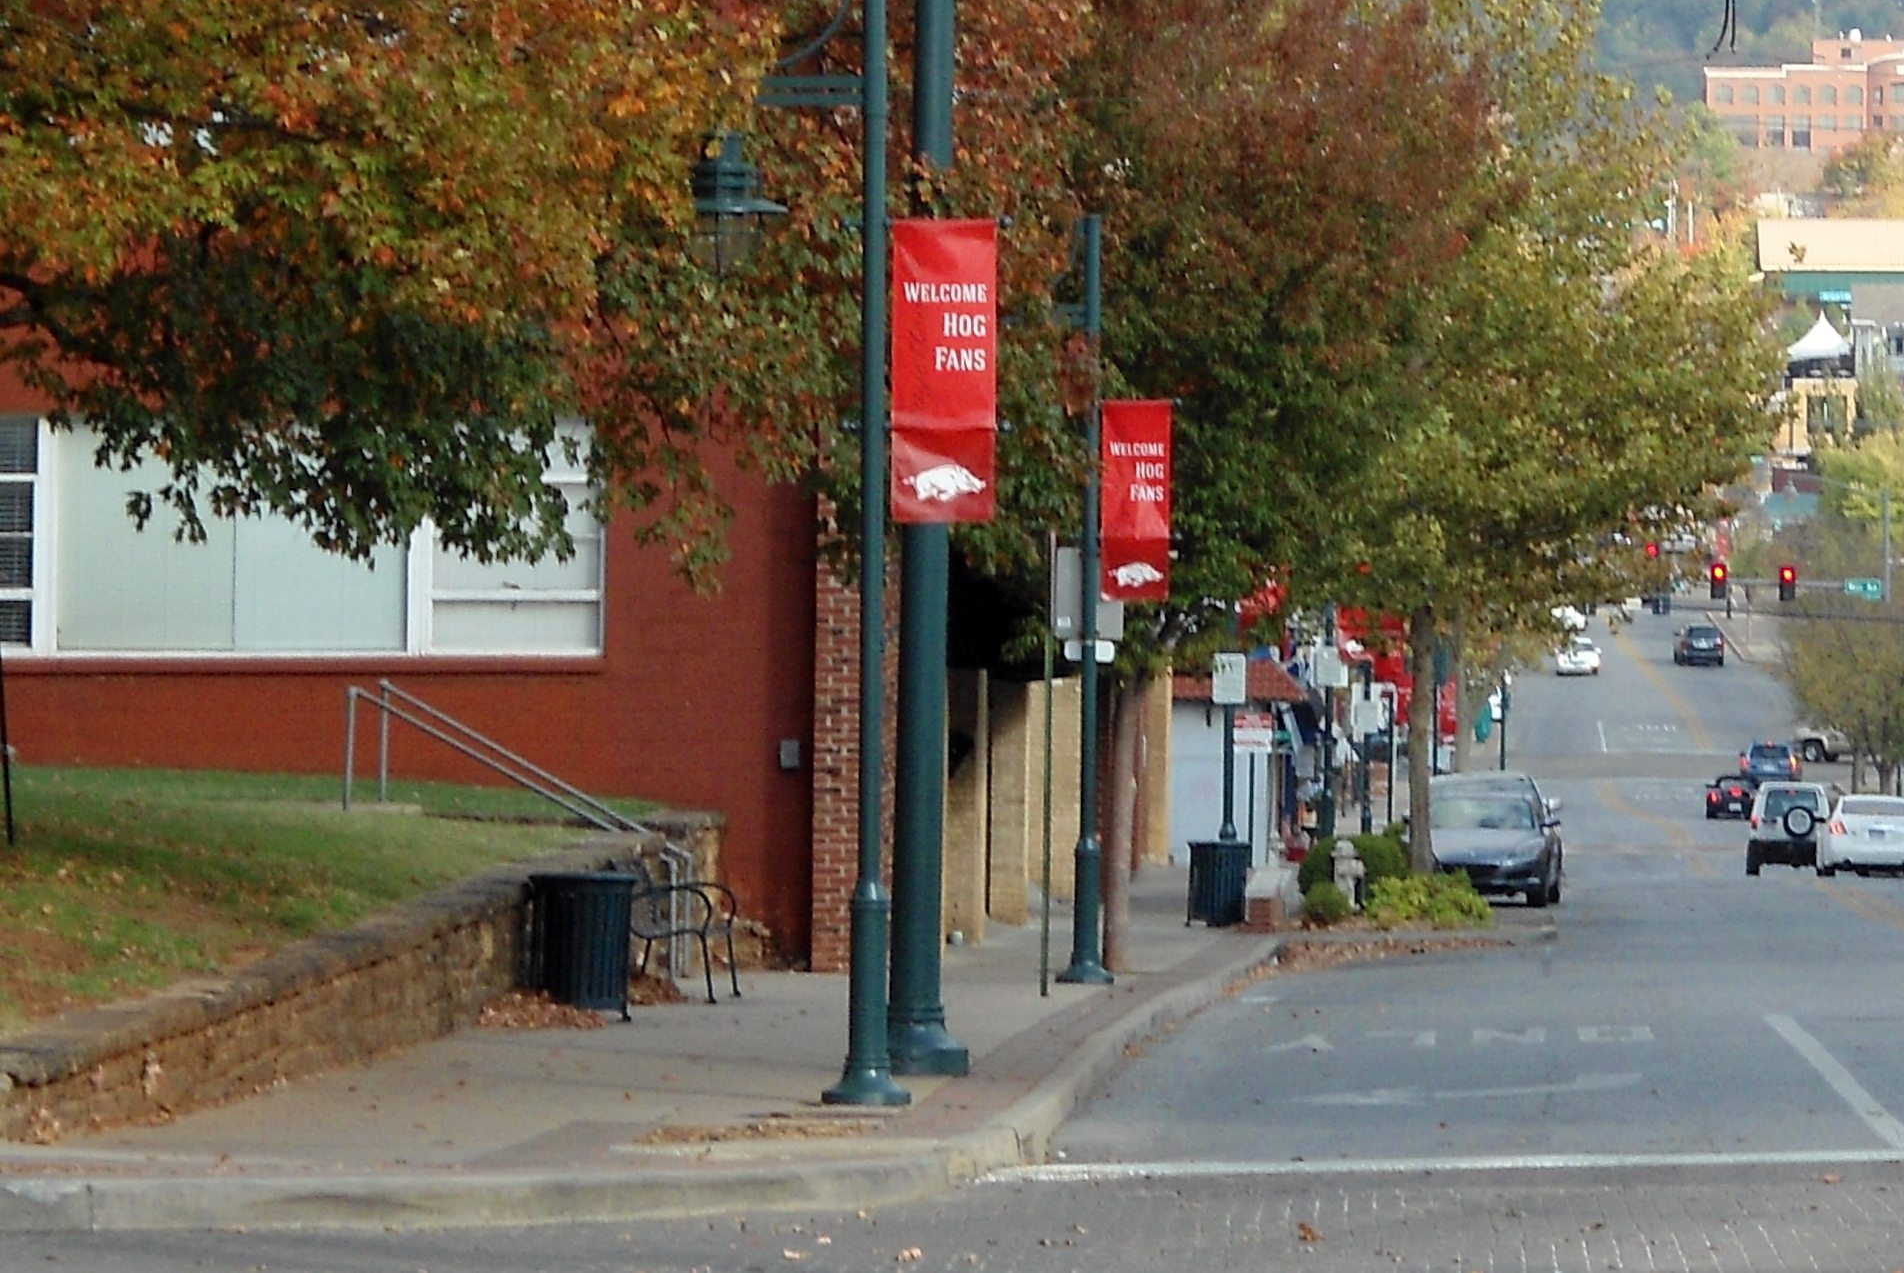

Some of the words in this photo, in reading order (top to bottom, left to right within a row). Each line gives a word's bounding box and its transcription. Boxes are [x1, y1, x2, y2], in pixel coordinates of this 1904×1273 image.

[903, 282, 988, 303] WELCOME
[943, 312, 987, 337] HOG
[935, 346, 986, 371] FANS
[1109, 441, 1165, 457] WELCOME
[1135, 461, 1164, 479] HOG
[1130, 483, 1164, 502] FANS
